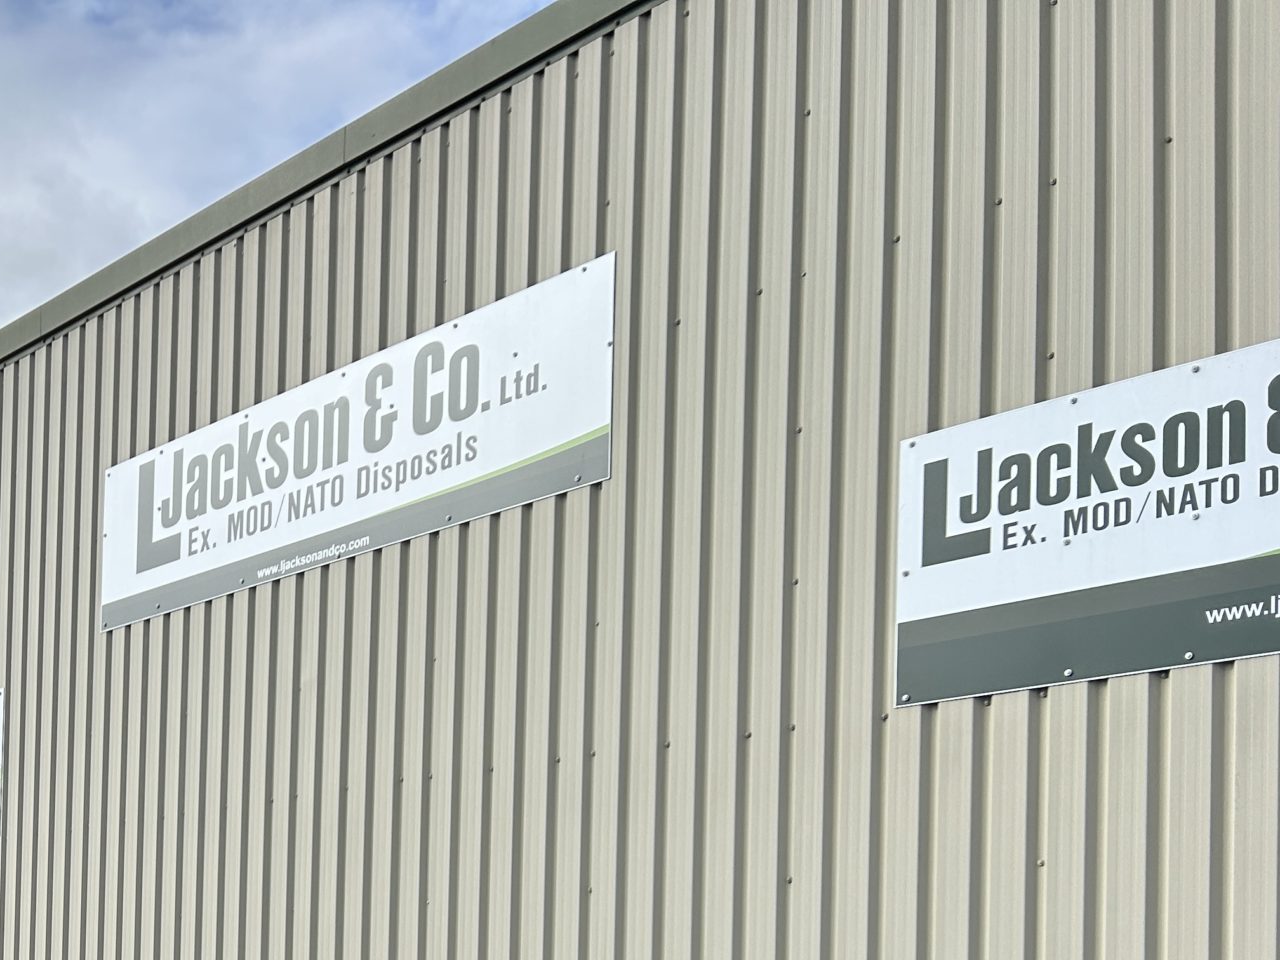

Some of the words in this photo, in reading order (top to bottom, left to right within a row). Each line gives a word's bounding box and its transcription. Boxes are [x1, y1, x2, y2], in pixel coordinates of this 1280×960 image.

[362, 362, 398, 454] &
[412, 340, 491, 436] Co.
[500, 363, 548, 406] Ltd.
[187, 526, 217, 558] Ex.
[226, 474, 345, 545] MOD/NATO
[356, 431, 479, 503] Disposals
[1002, 520, 1047, 551] Ex.
[1063, 473, 1241, 539] MOD/NATO
